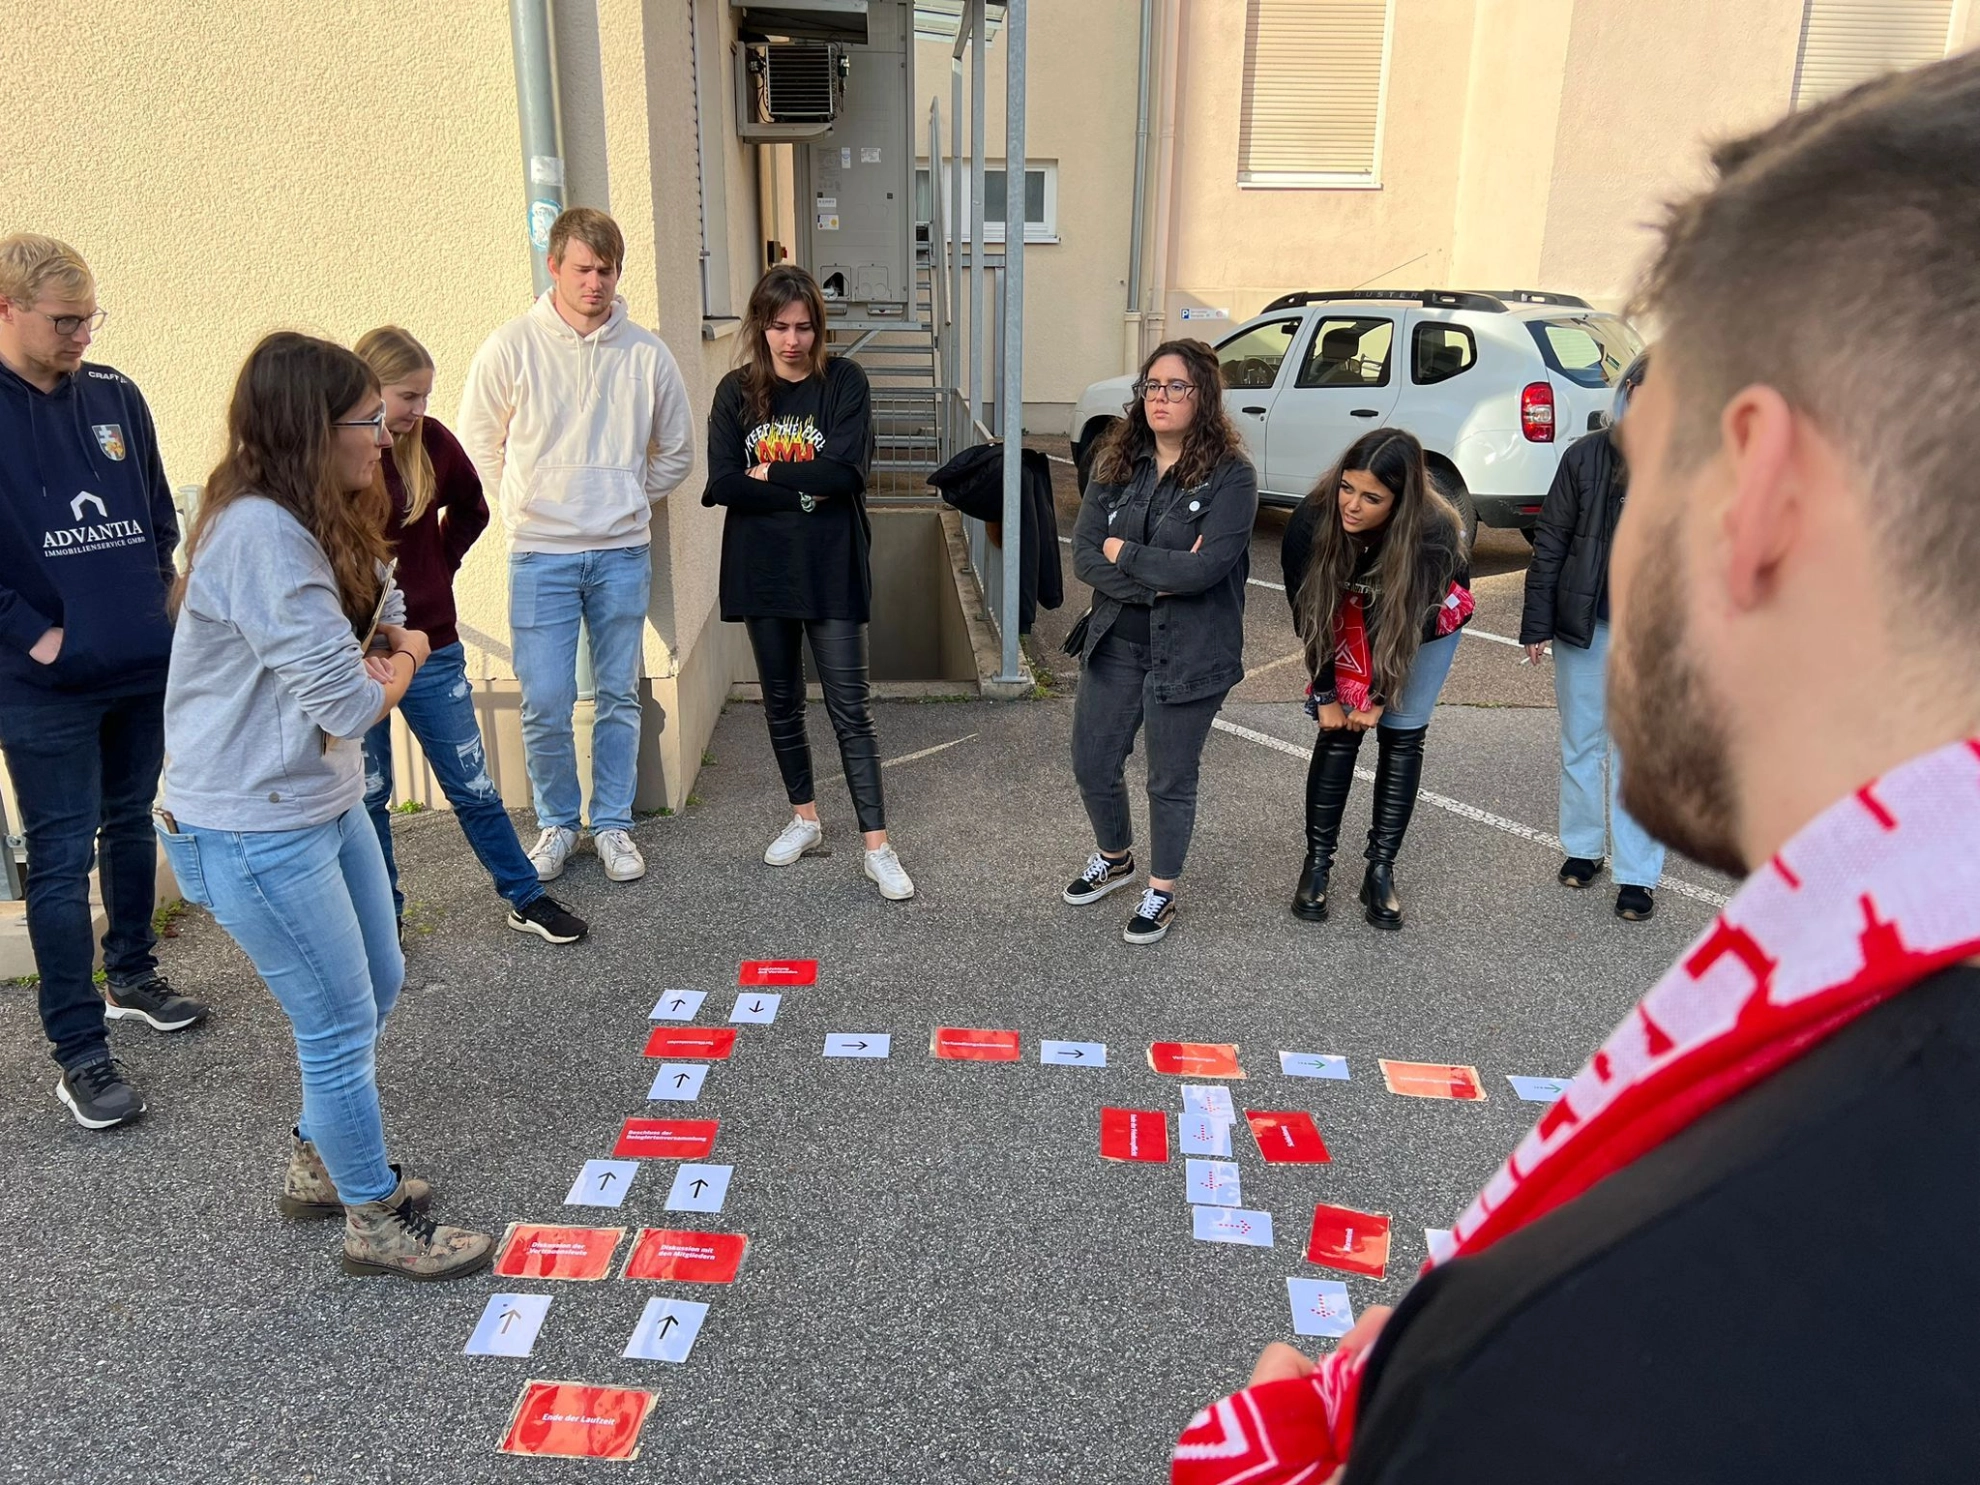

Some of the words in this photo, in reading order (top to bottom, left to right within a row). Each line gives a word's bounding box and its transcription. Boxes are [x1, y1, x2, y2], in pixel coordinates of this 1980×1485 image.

[1354, 291, 1418, 299] DUSTER
[88, 371, 119, 381] CRAFT
[745, 423, 770, 453] KEEP
[775, 421, 799, 436] THE
[42, 519, 144, 548] ADVANTIA
[44, 539, 126, 558] IMMOBILIENSERVICE
[531, 1241, 571, 1249] Diskussion
[661, 1244, 700, 1252] Diskussion
[700, 1246, 714, 1254] mit
[528, 1247, 588, 1256] Vertrauensleute
[672, 1251, 716, 1261] Mitgliedern
[541, 1413, 564, 1421] Ende
[565, 1414, 579, 1422] der
[580, 1415, 616, 1426] Laufzeit
